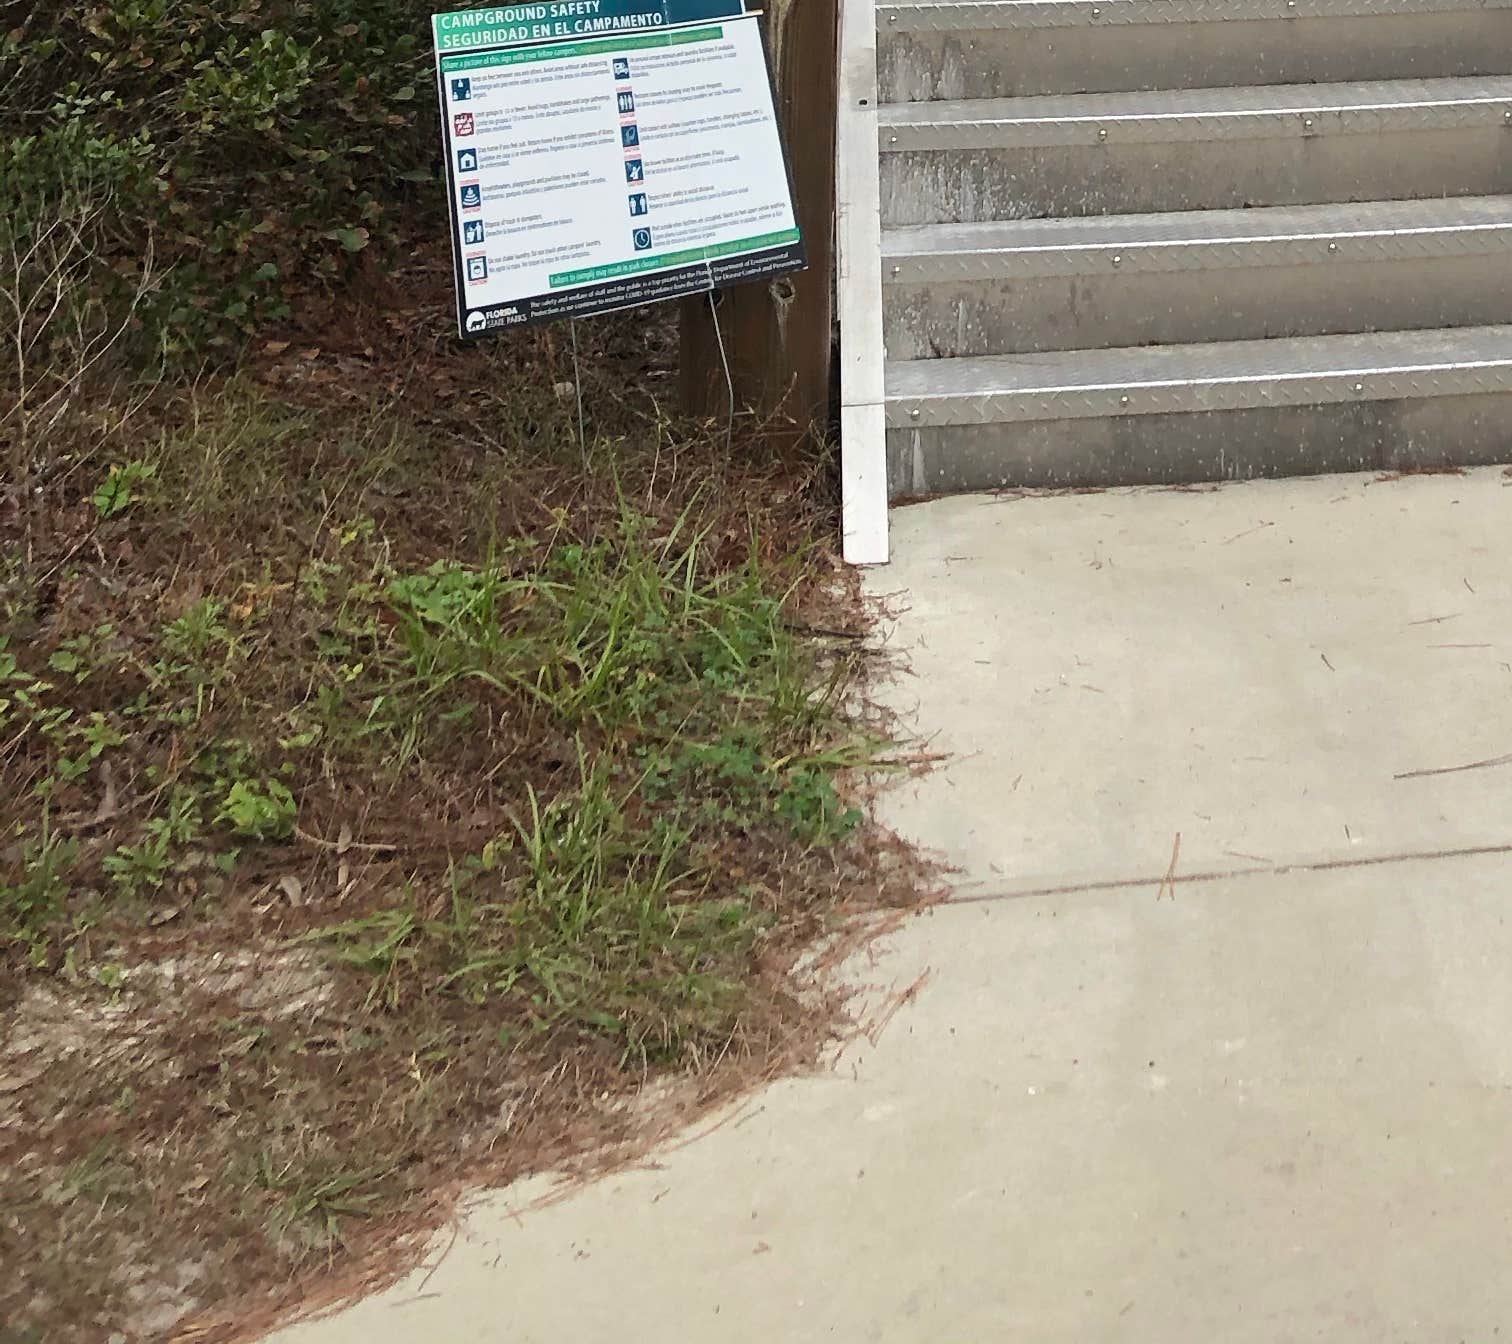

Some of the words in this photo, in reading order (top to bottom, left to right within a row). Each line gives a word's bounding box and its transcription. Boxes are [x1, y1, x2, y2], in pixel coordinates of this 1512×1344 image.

[441, 6, 546, 29] CAMPGROUND
[550, 0, 600, 18] SAFETY
[443, 27, 528, 48] SEGURIDAD
[533, 24, 551, 38] EN
[555, 22, 571, 35] EL
[574, 13, 662, 33] CAMPAMENTO
[486, 307, 518, 319] FLORIDA
